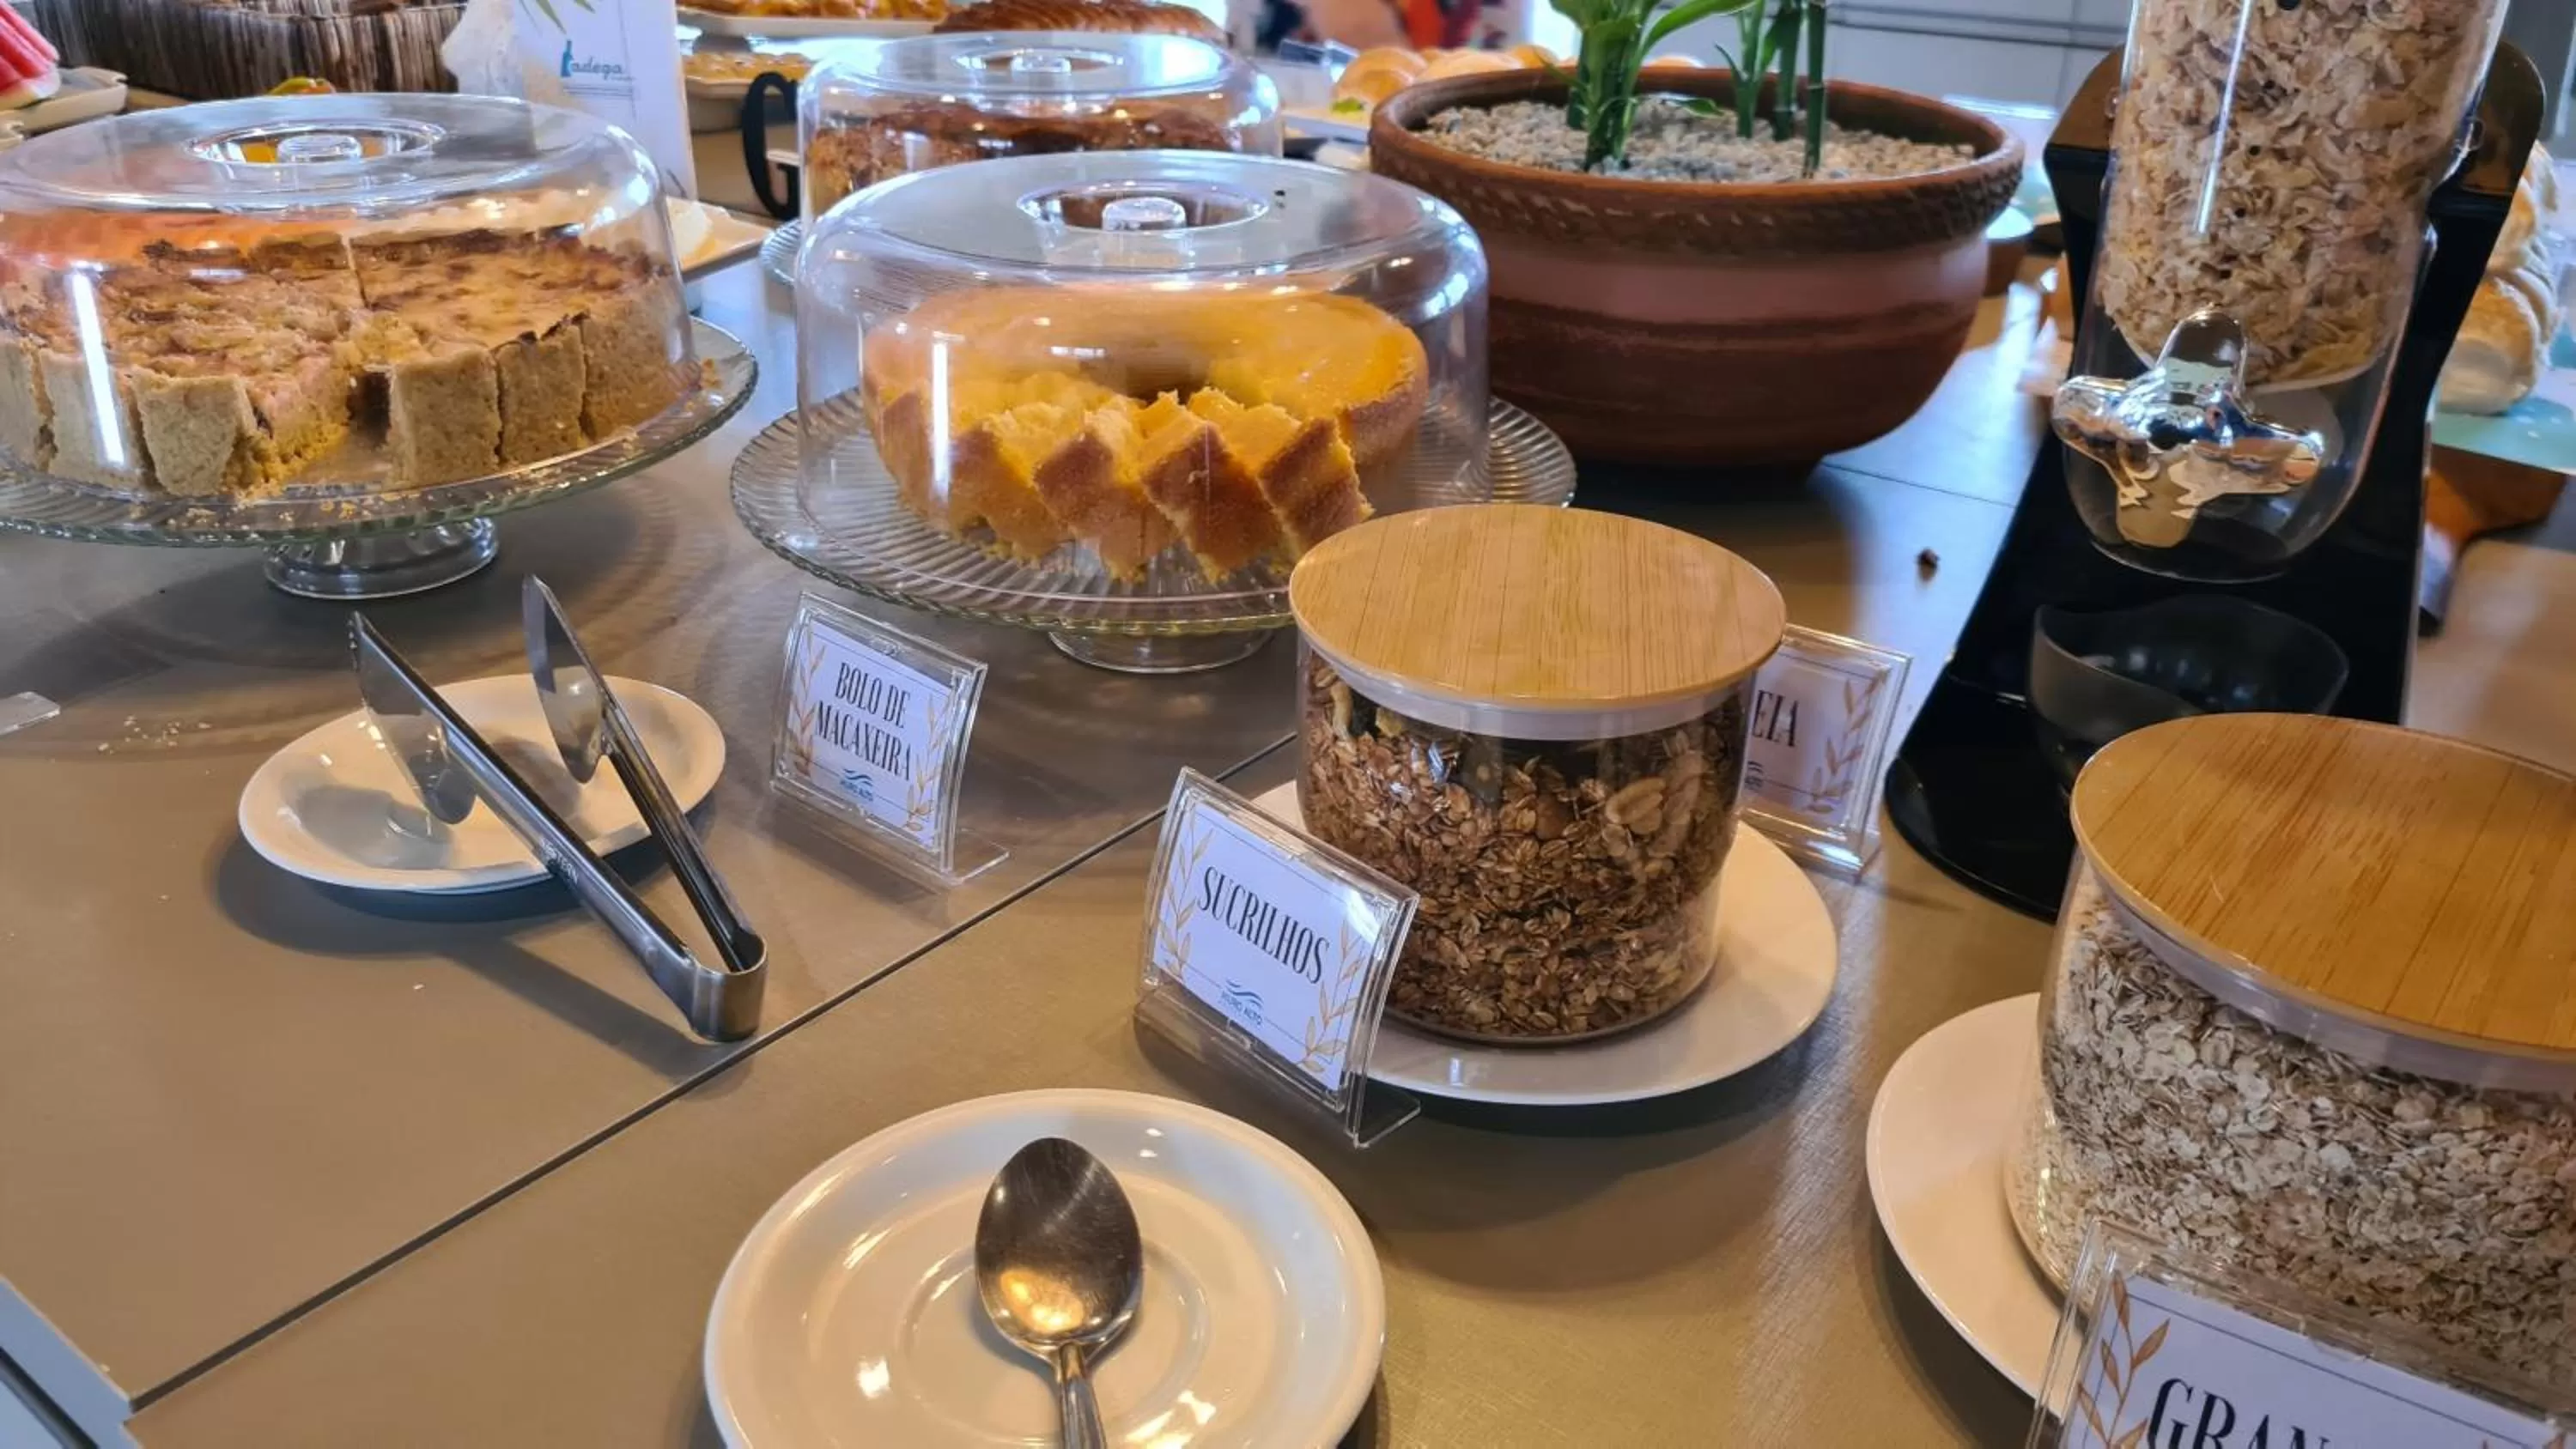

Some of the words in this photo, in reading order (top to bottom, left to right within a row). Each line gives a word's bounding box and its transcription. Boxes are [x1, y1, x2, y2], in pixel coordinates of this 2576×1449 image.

[835, 662, 883, 714] BOLO
[884, 684, 910, 728] DE
[1753, 689, 1800, 747] EIA
[815, 700, 911, 781] MACAXEIRA
[1198, 866, 1330, 985] SUCRILHOS
[2147, 1378, 2330, 1449] GR
